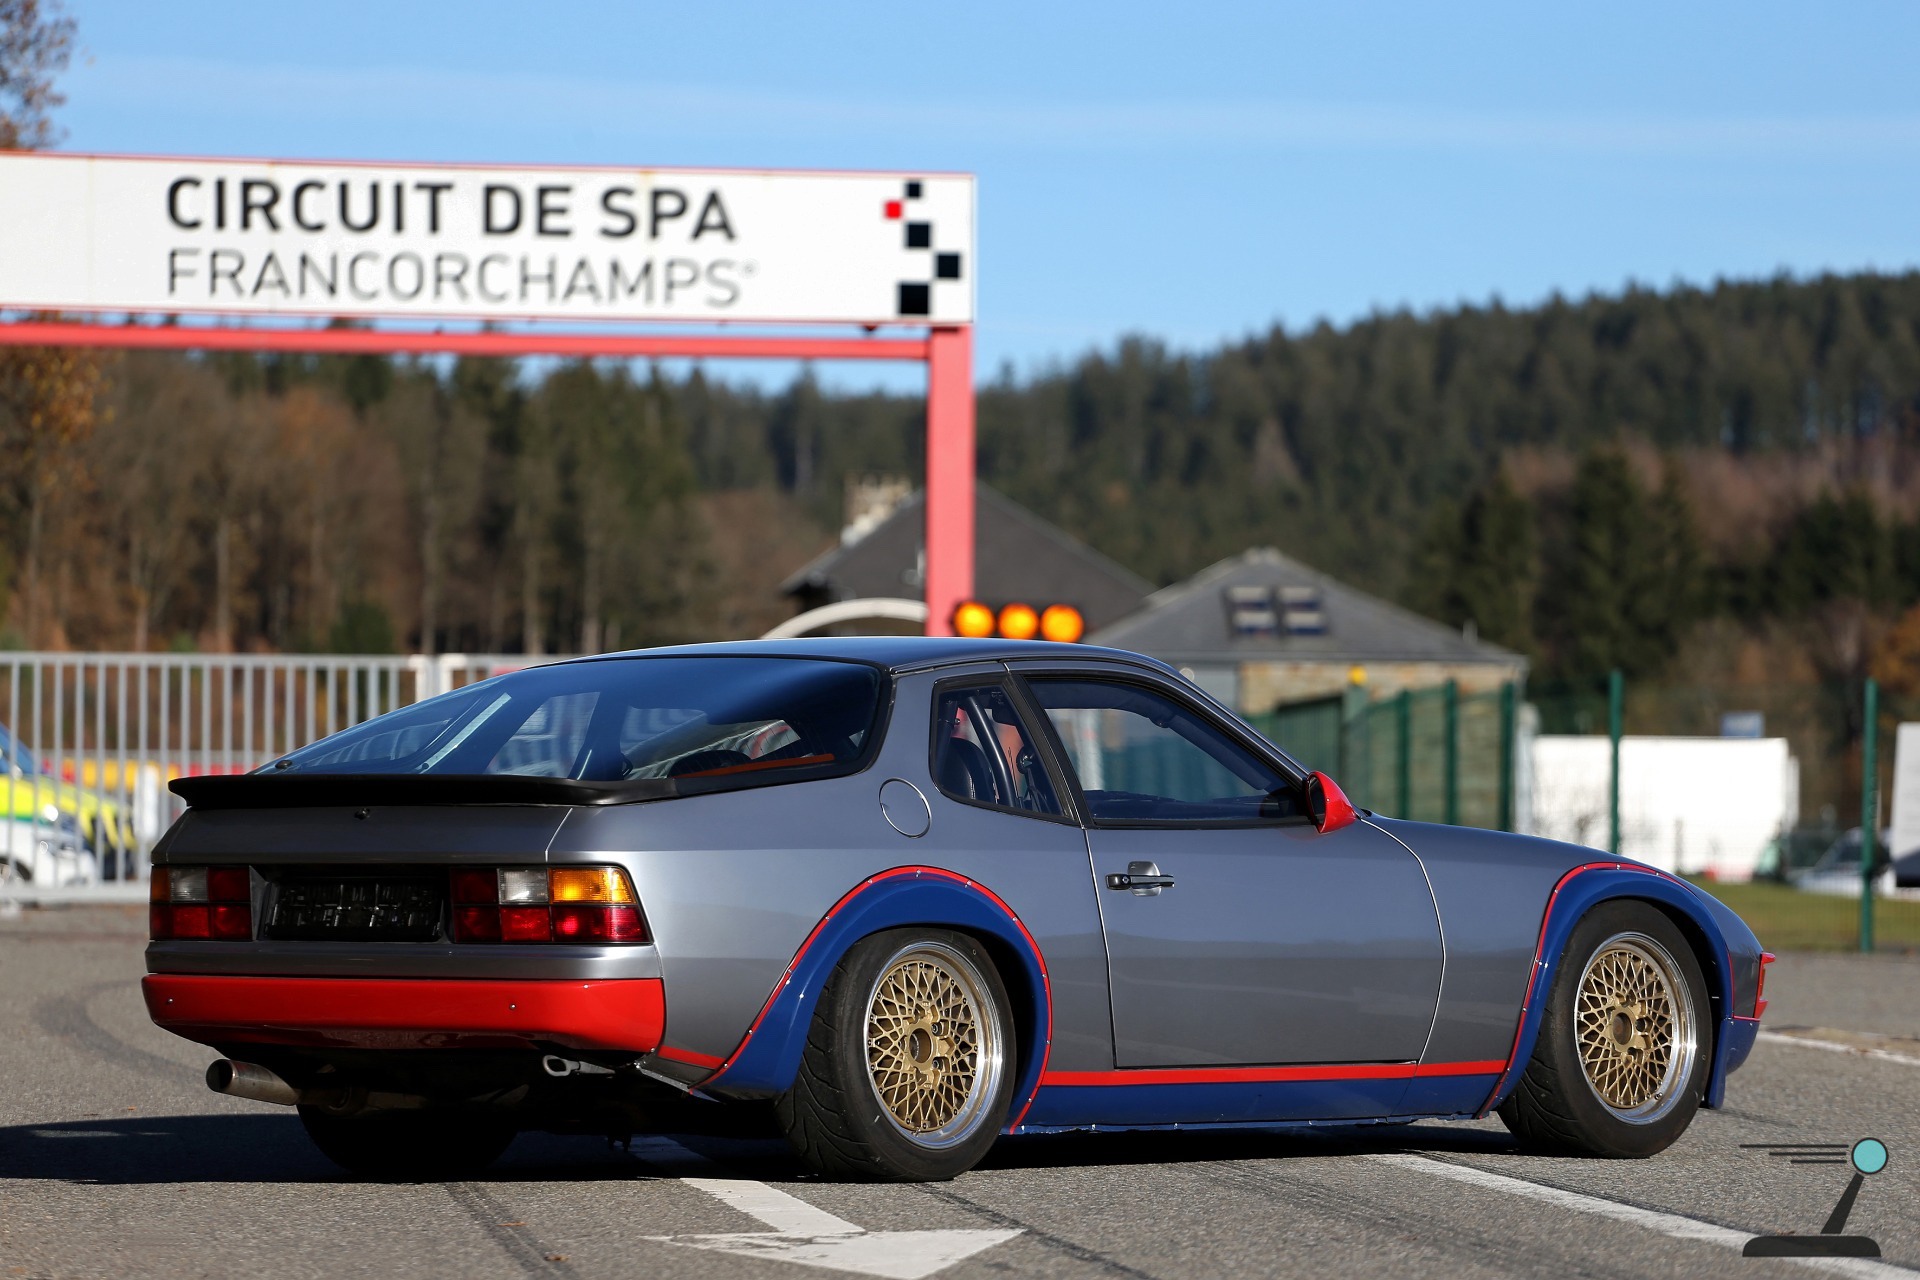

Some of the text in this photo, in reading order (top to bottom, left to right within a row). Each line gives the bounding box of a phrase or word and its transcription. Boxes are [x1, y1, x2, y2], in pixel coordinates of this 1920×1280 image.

[167, 176, 737, 241] CIRCUIT DE SPA
